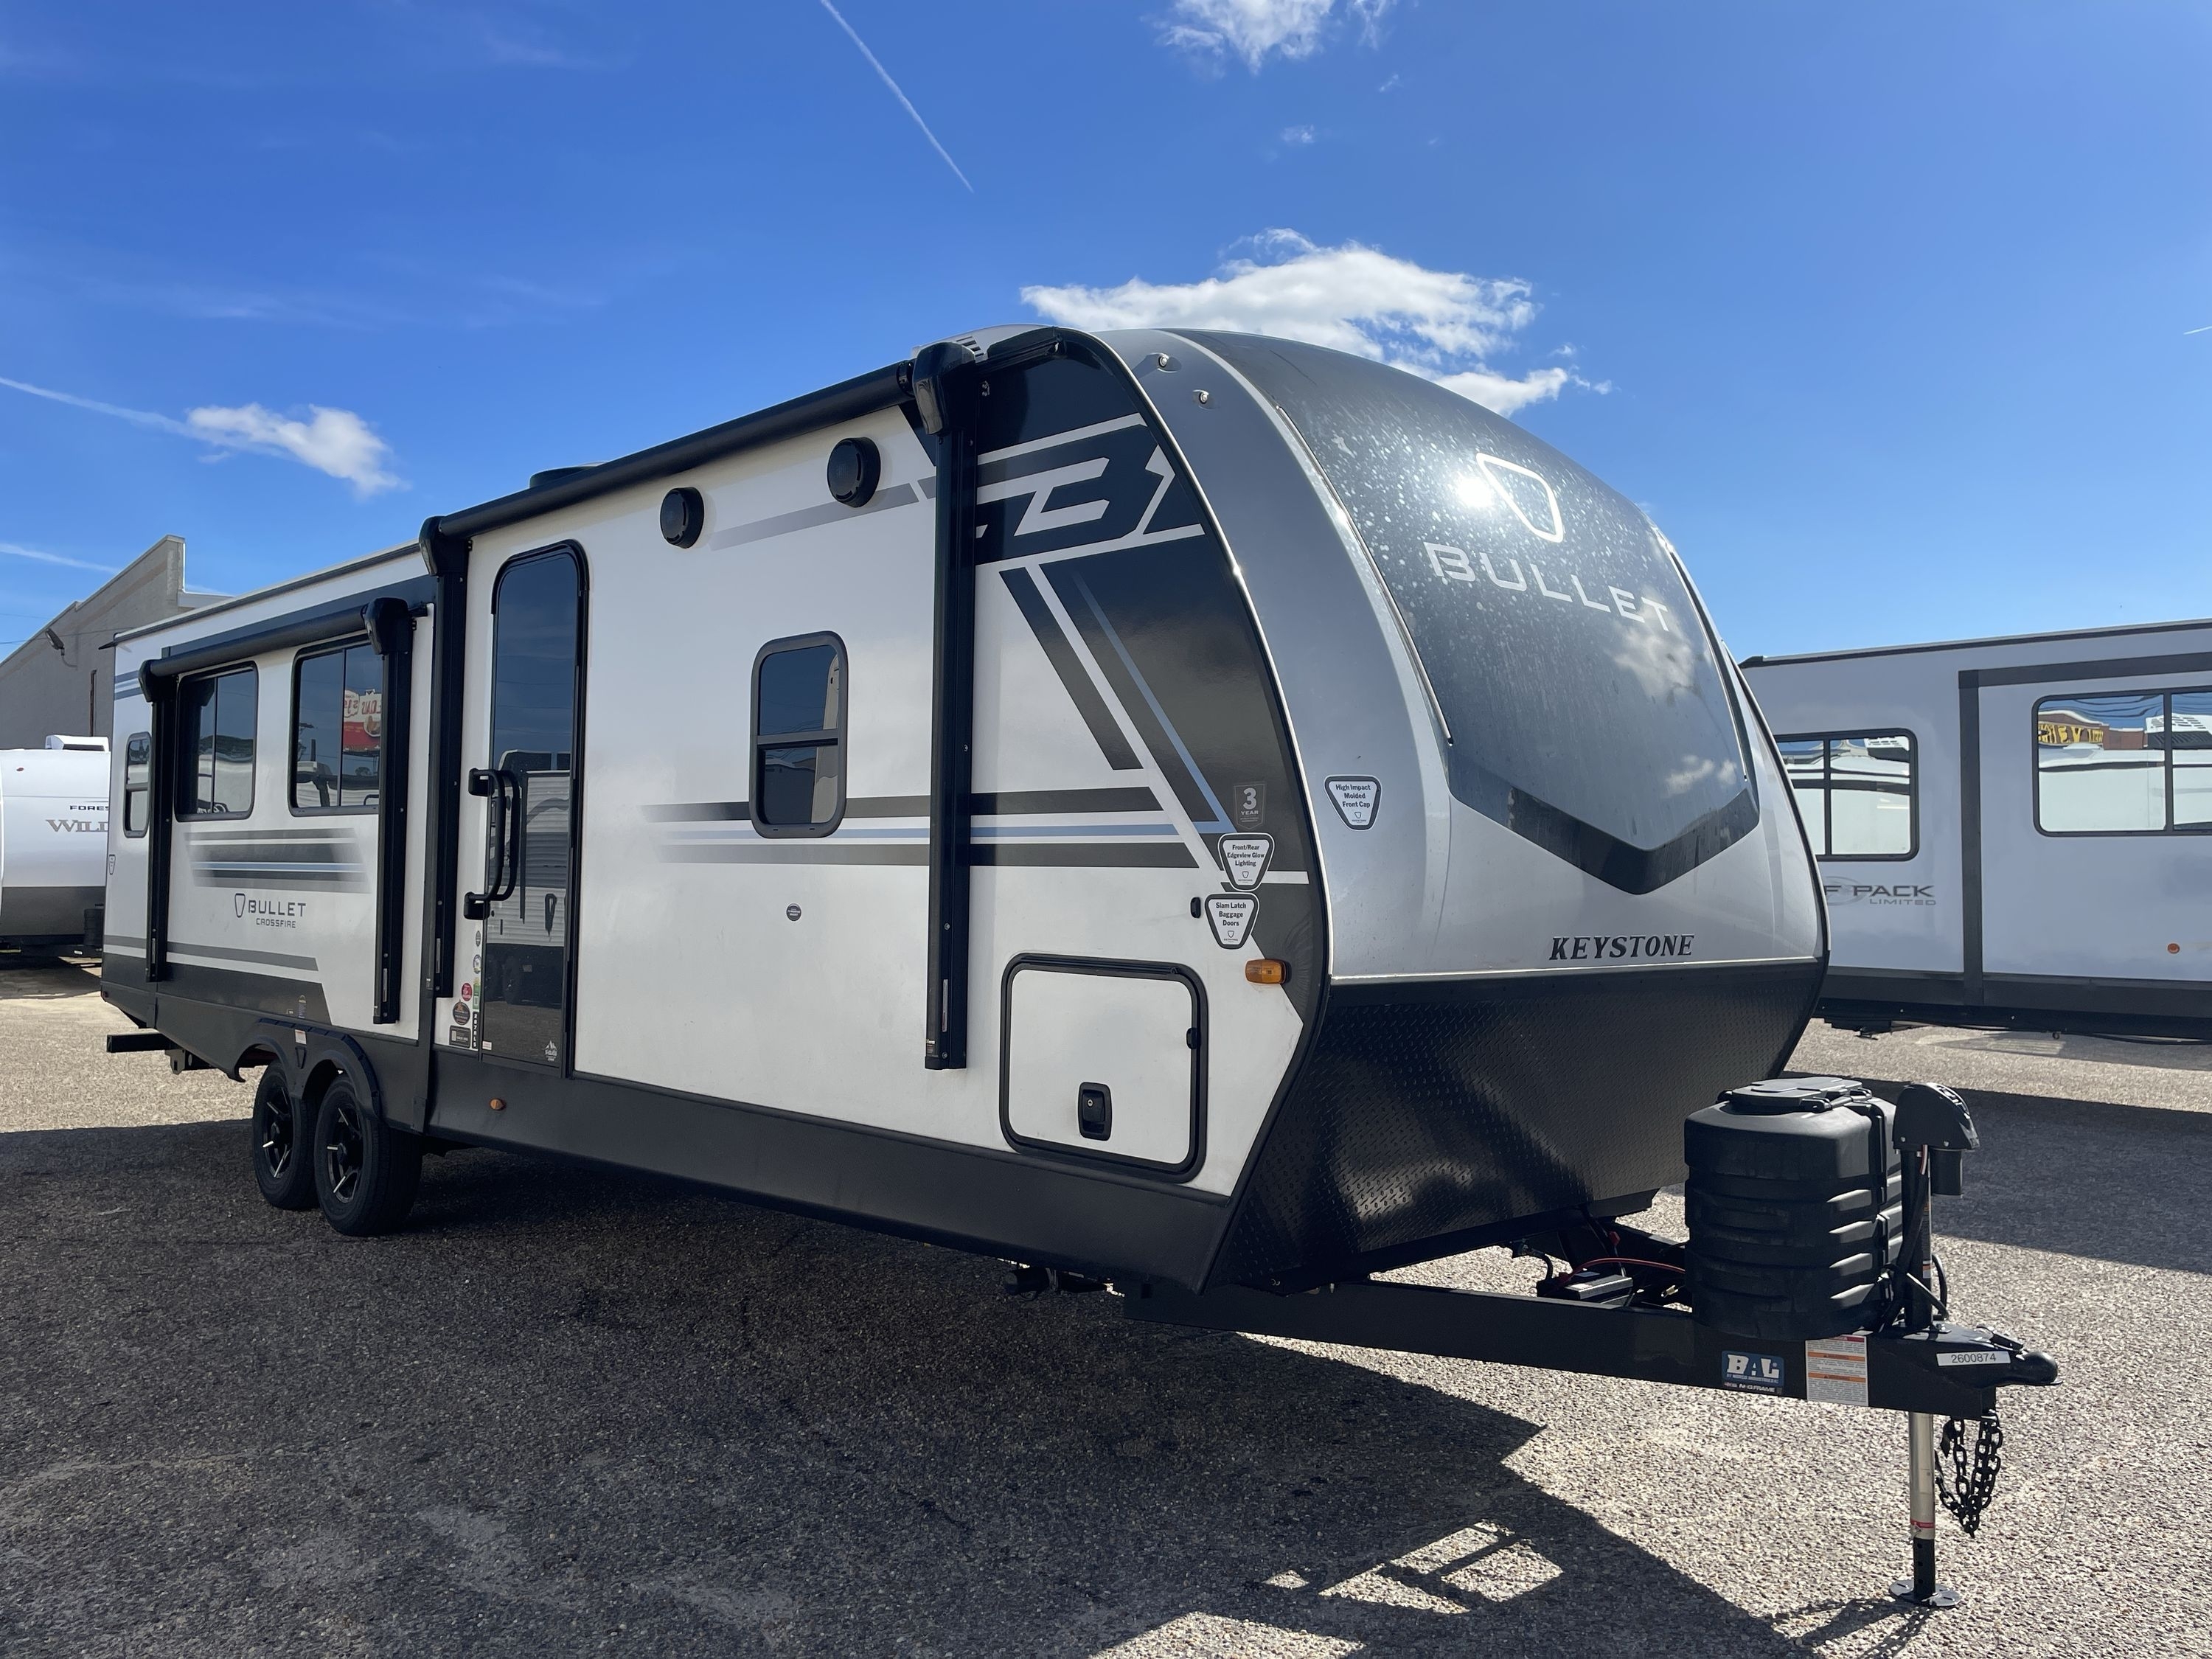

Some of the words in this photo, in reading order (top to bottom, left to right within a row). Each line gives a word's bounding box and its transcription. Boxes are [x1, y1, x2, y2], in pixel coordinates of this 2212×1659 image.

[1423, 542, 1669, 632] BULLET
[1243, 787, 1257, 810] 3
[1853, 885, 1935, 897] PACK
[248, 900, 306, 917] BULLET
[256, 918, 296, 928] CROSSFIRE
[1549, 935, 1694, 960] KEYSTONE
[1951, 1353, 1996, 1363] 2600874
